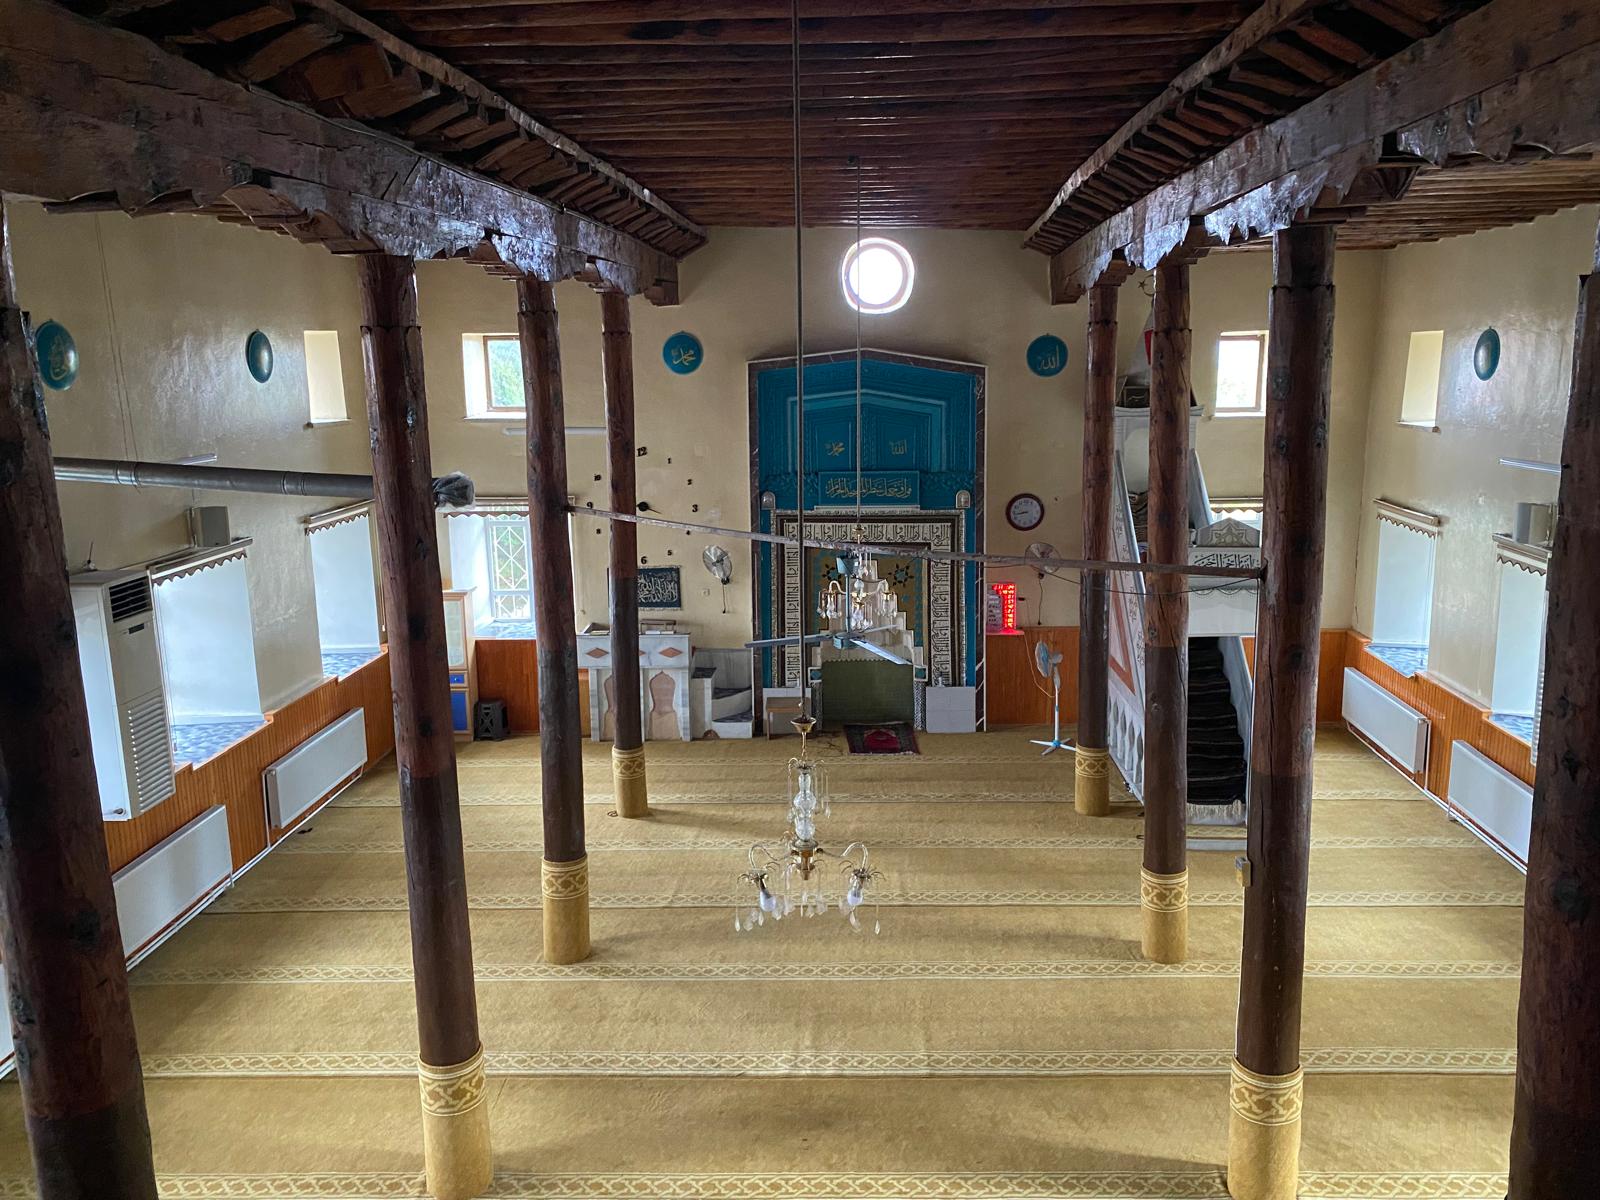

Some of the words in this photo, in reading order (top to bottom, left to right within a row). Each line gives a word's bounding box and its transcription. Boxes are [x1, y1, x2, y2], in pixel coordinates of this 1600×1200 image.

[637, 447, 648, 457] 12
[692, 504, 698, 512] 3
[641, 556, 647, 564] 6
